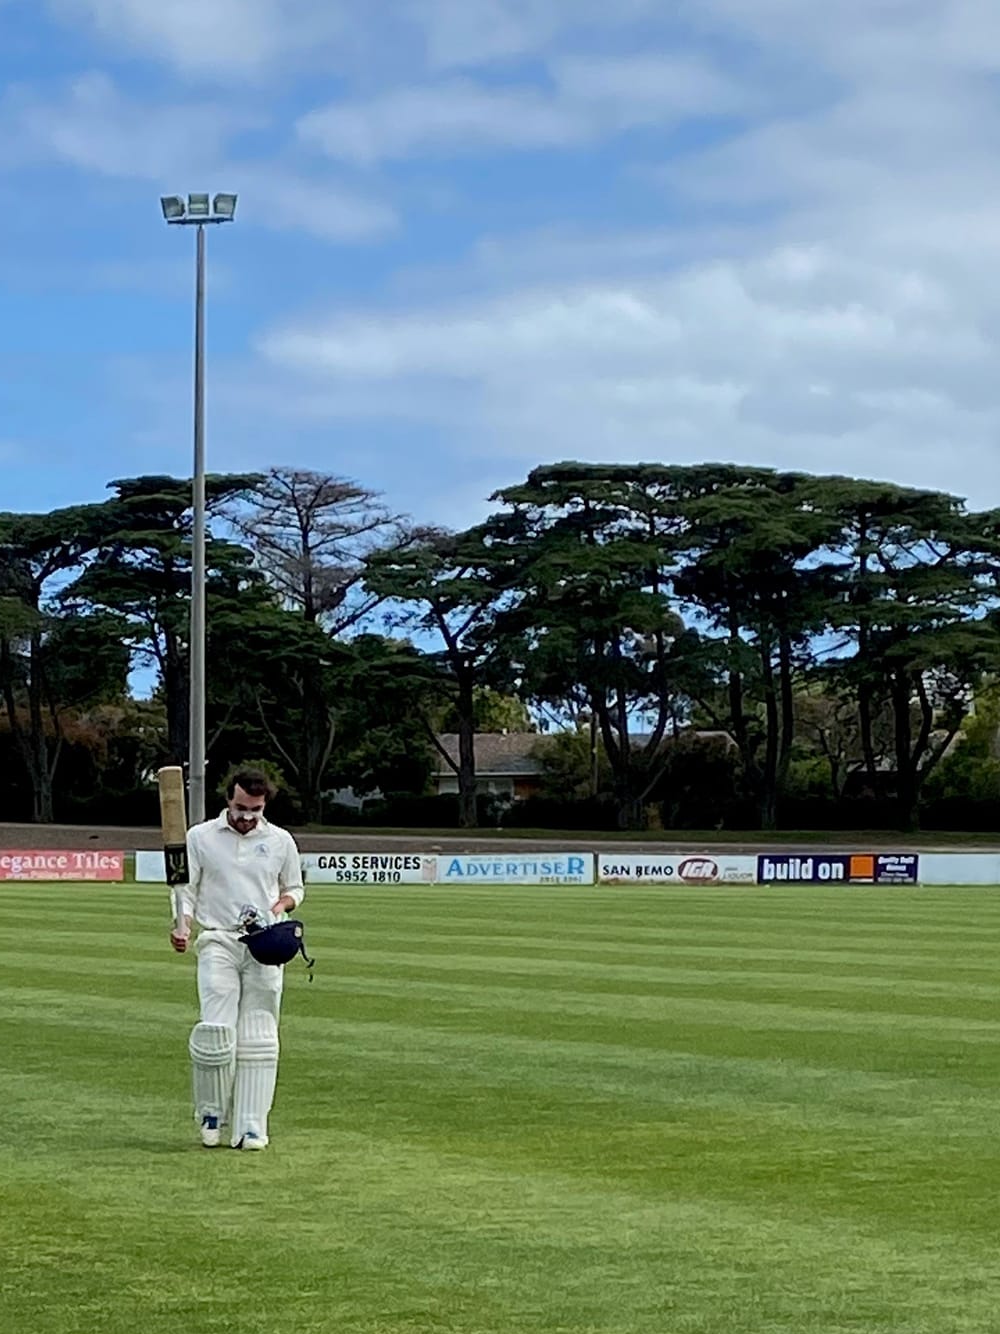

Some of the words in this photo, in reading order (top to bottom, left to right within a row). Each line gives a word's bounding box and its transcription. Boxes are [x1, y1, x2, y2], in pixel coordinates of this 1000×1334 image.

[72, 852, 120, 869] Tiles
[318, 856, 347, 869] GAS
[351, 856, 421, 870] SERVICES
[446, 857, 585, 876] ADVERTISER
[762, 858, 814, 880] build
[818, 861, 844, 880] on
[336, 870, 368, 883] 5952
[372, 870, 401, 883] 1810
[602, 864, 631, 876] SAN
[636, 864, 674, 877] REMO
[682, 861, 715, 878] IGA
